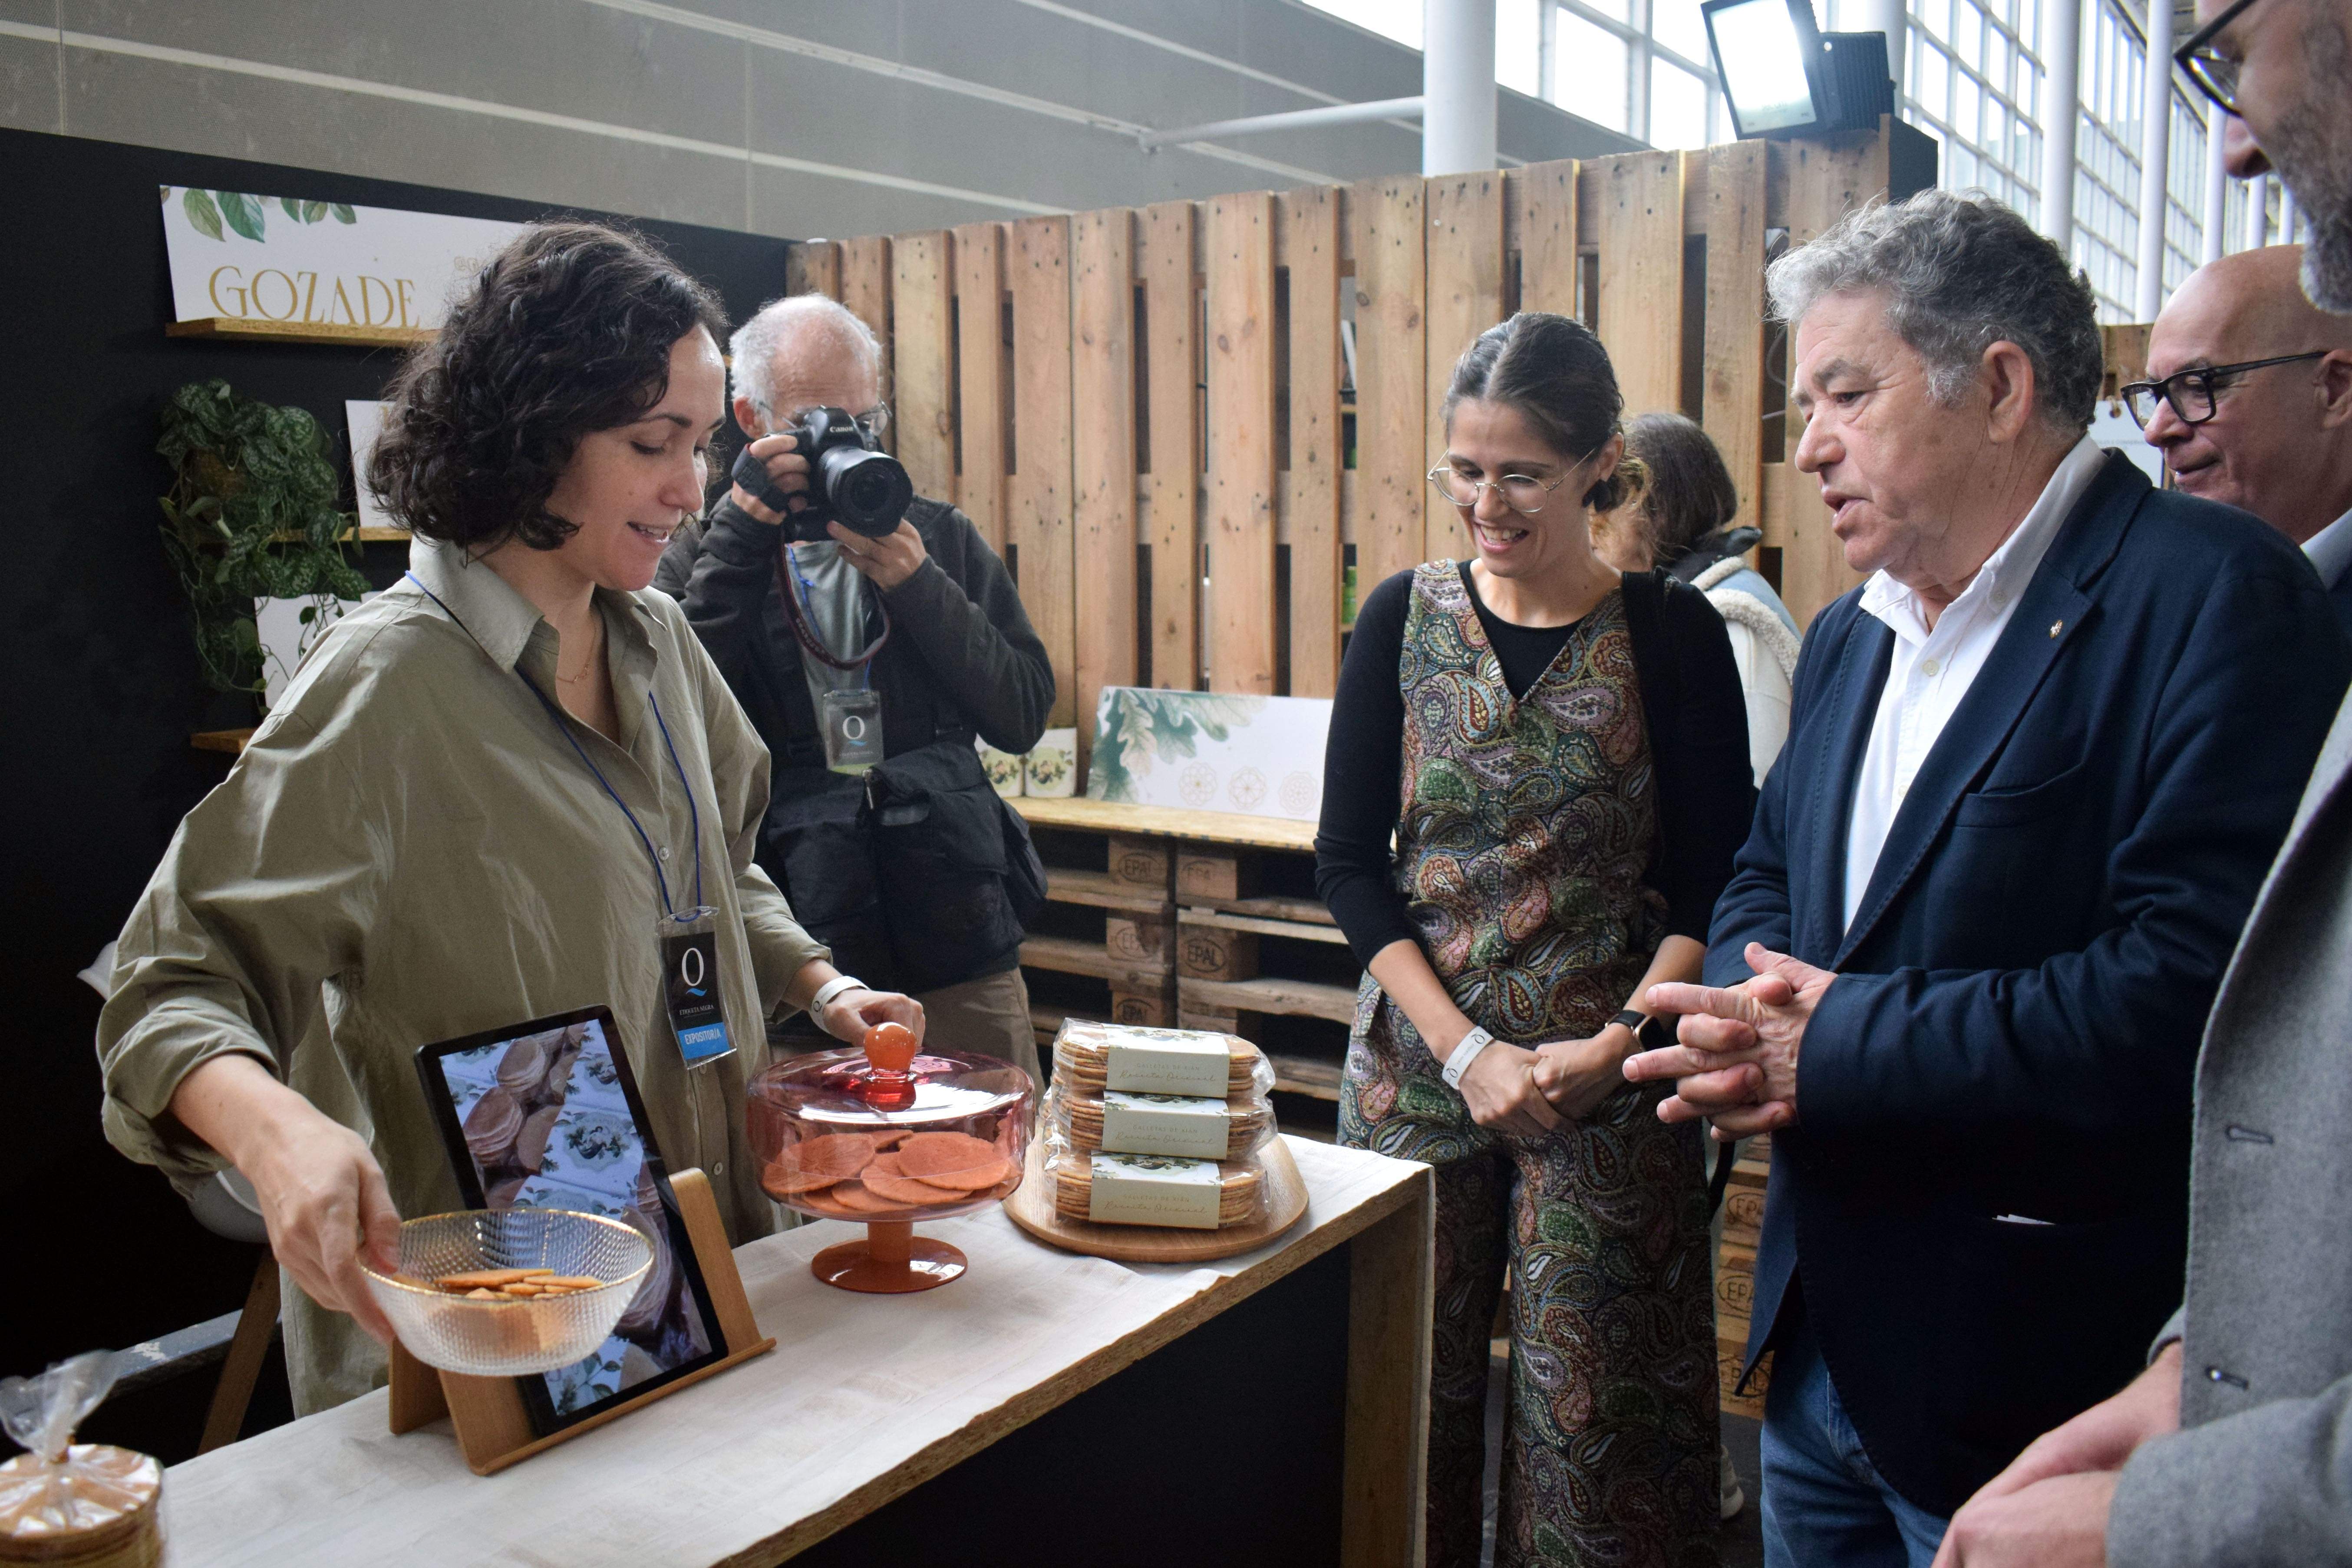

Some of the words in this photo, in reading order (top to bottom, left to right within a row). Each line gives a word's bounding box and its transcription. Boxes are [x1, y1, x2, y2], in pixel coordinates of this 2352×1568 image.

[209, 265, 420, 329] GOZADE
[1188, 942, 1217, 967] EPAL
[679, 1007, 700, 1016] ETIQUETA
[684, 1028, 721, 1045] EXPOSITOR/A
